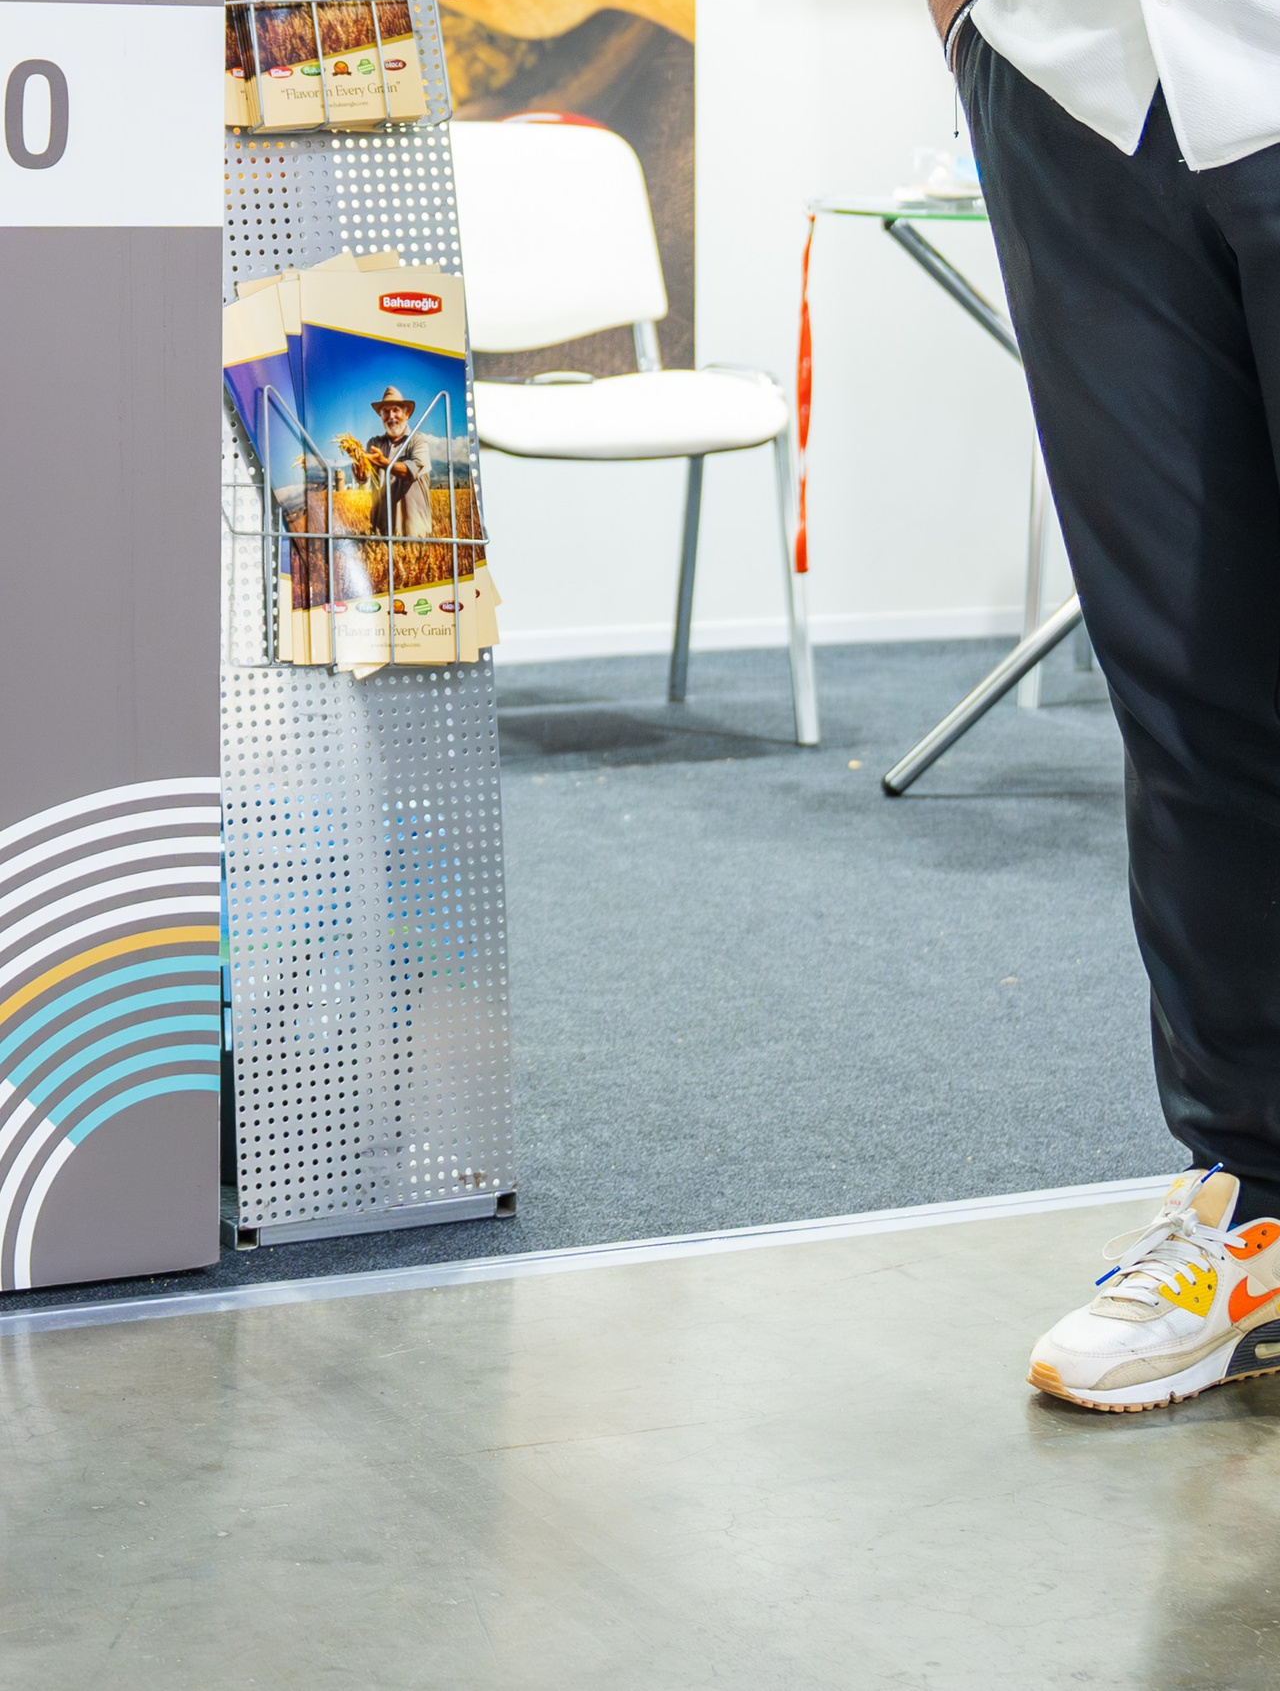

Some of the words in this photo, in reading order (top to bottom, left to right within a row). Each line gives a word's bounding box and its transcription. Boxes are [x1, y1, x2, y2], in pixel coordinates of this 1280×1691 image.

[335, 85, 364, 96] Every
[5, 59, 69, 169] 0
[383, 297, 439, 311] Baharoğlu
